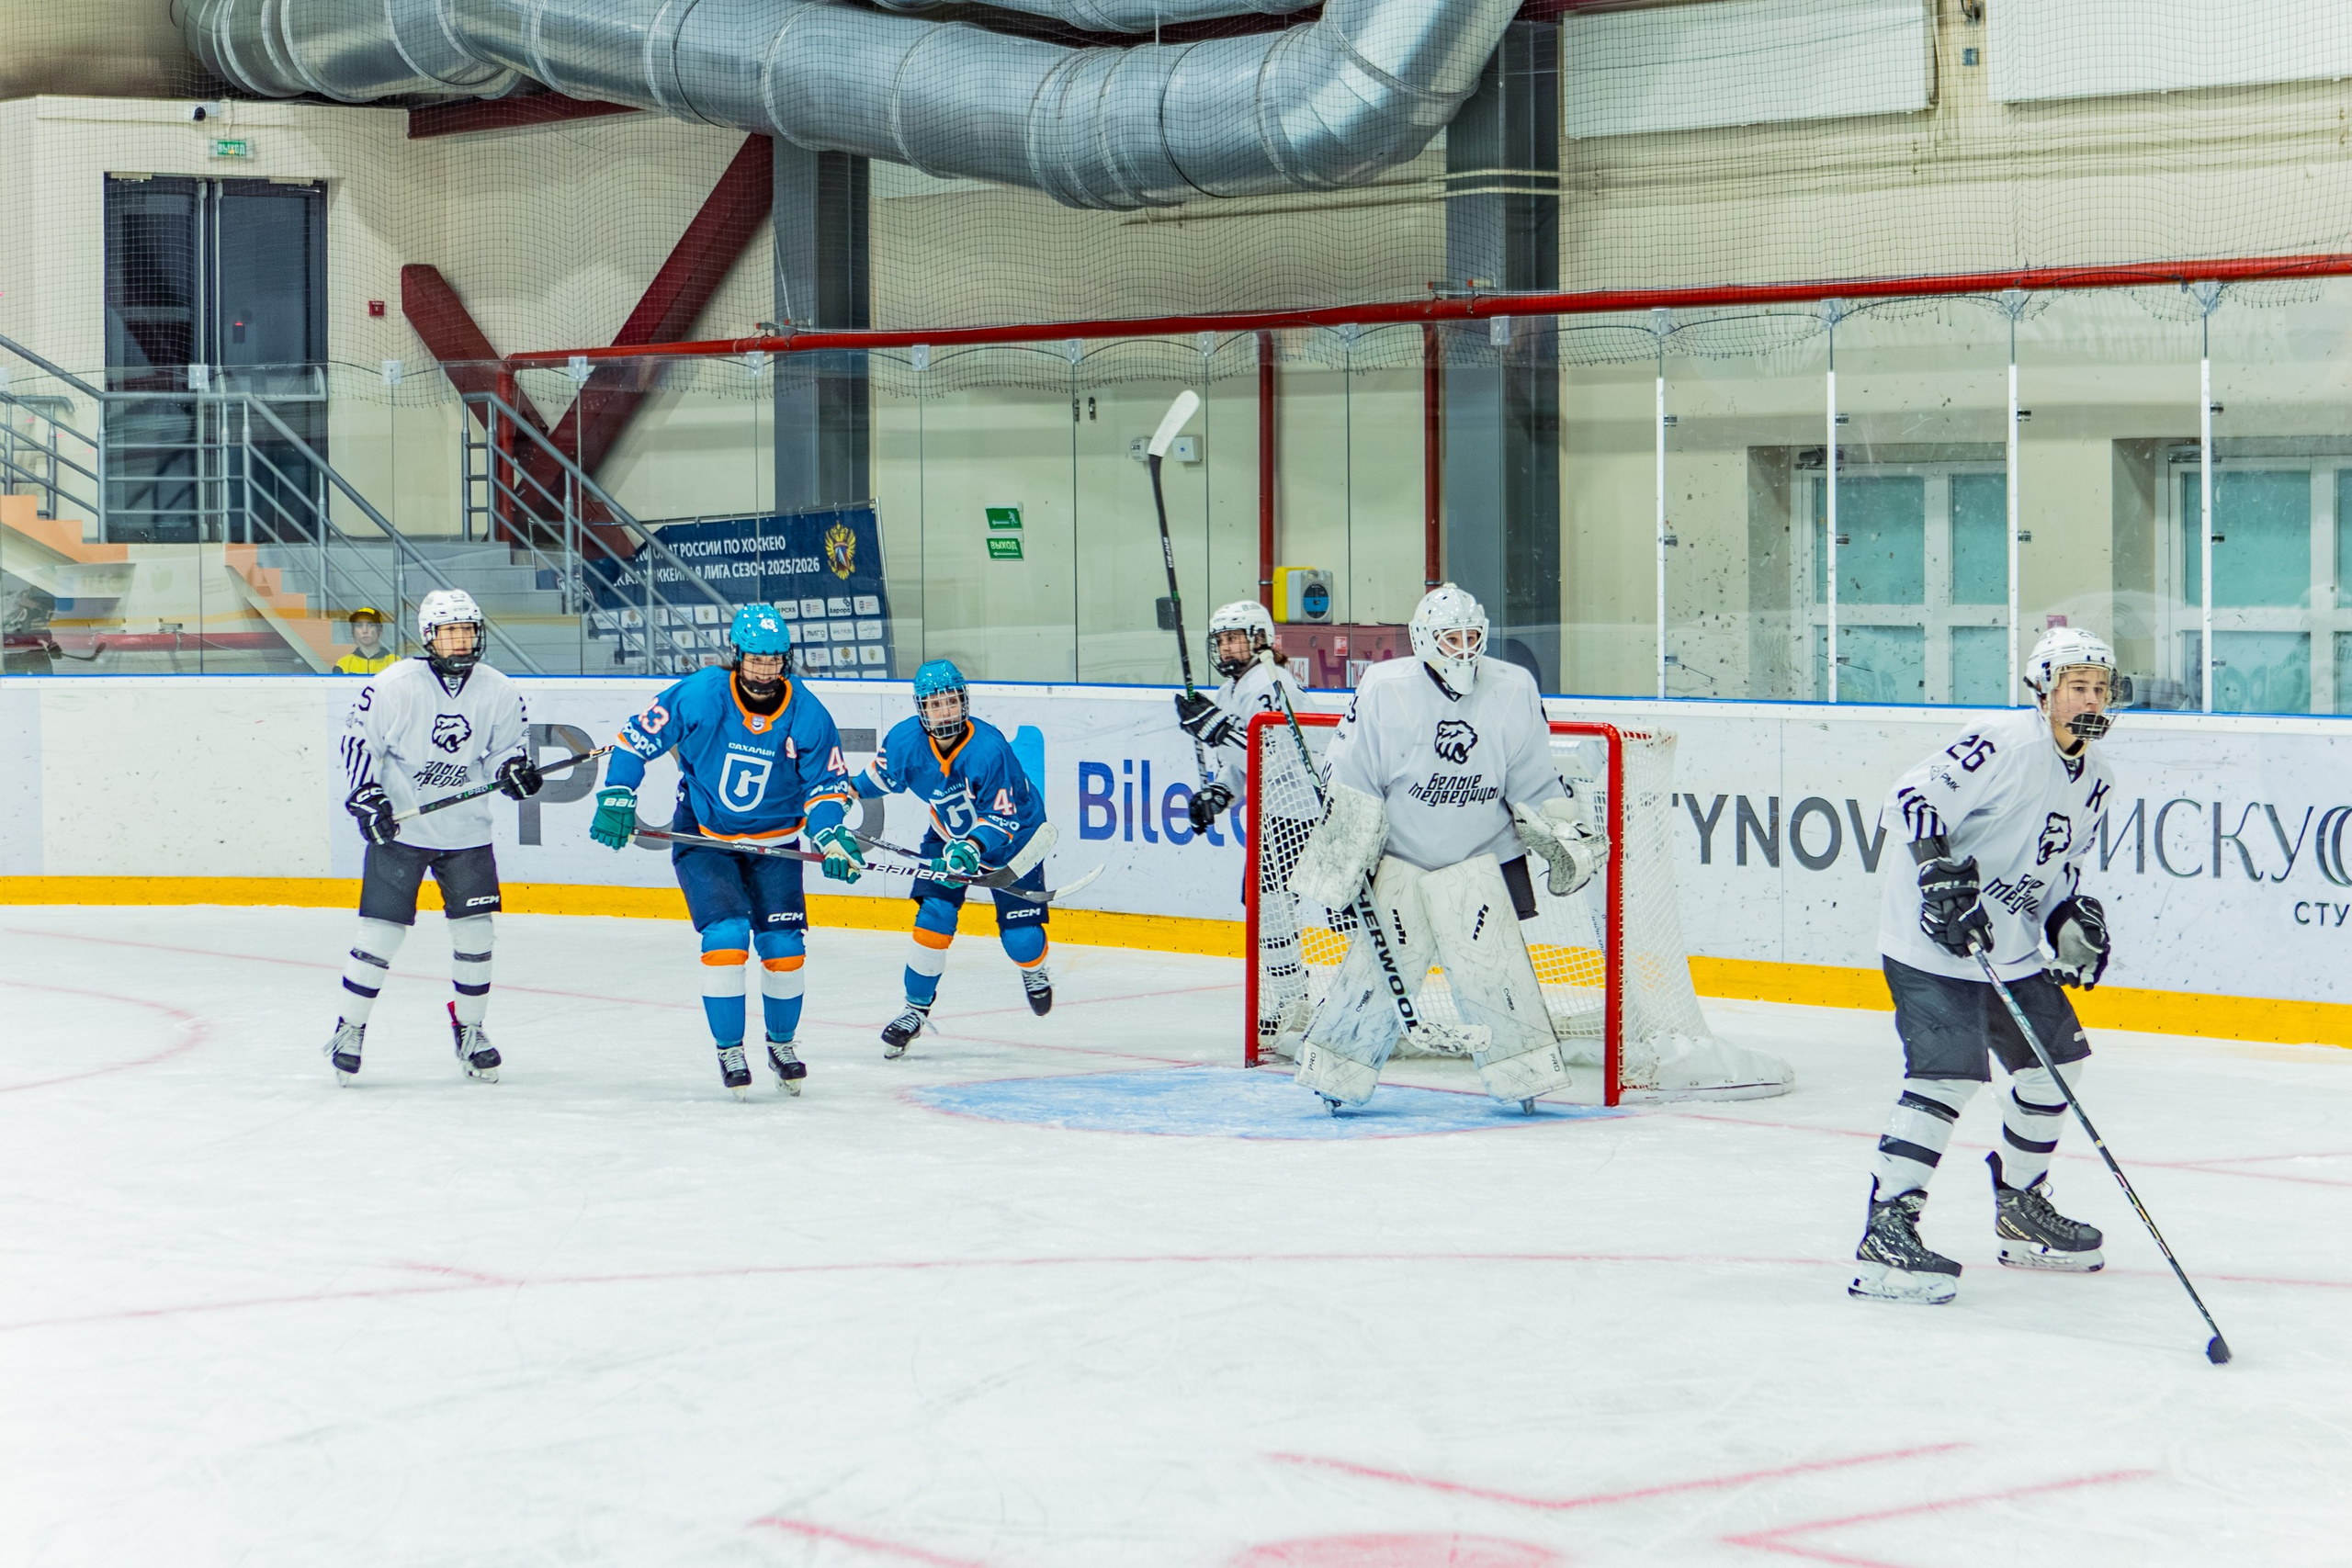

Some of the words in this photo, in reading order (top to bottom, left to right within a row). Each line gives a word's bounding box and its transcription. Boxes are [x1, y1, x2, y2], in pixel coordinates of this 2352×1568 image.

[218, 143, 246, 156] ВЫХОД
[680, 541, 722, 558] РОССИИ
[724, 539, 740, 554] ПО
[741, 536, 786, 553] ХОККЕЮ
[989, 541, 1018, 551] ВЫХОД
[704, 564, 731, 580] ЛИГА
[732, 559, 766, 578] СЕЗОН
[768, 558, 820, 575] 2025/2026
[353, 686, 375, 712] 5
[729, 741, 775, 757] САХАЛИН
[1946, 734, 1996, 773] 26
[827, 745, 848, 776] 4
[1427, 773, 1483, 791] Белые
[1408, 782, 1499, 807] медведицы
[2085, 777, 2110, 814] К
[1672, 793, 1888, 874] YNOV
[873, 863, 949, 882] BAUER
[466, 894, 500, 908] CCM
[767, 912, 805, 923] CCM
[1006, 908, 1041, 919] CCM
[1308, 1052, 1317, 1071] PRO
[1549, 1053, 1561, 1072] PRO
